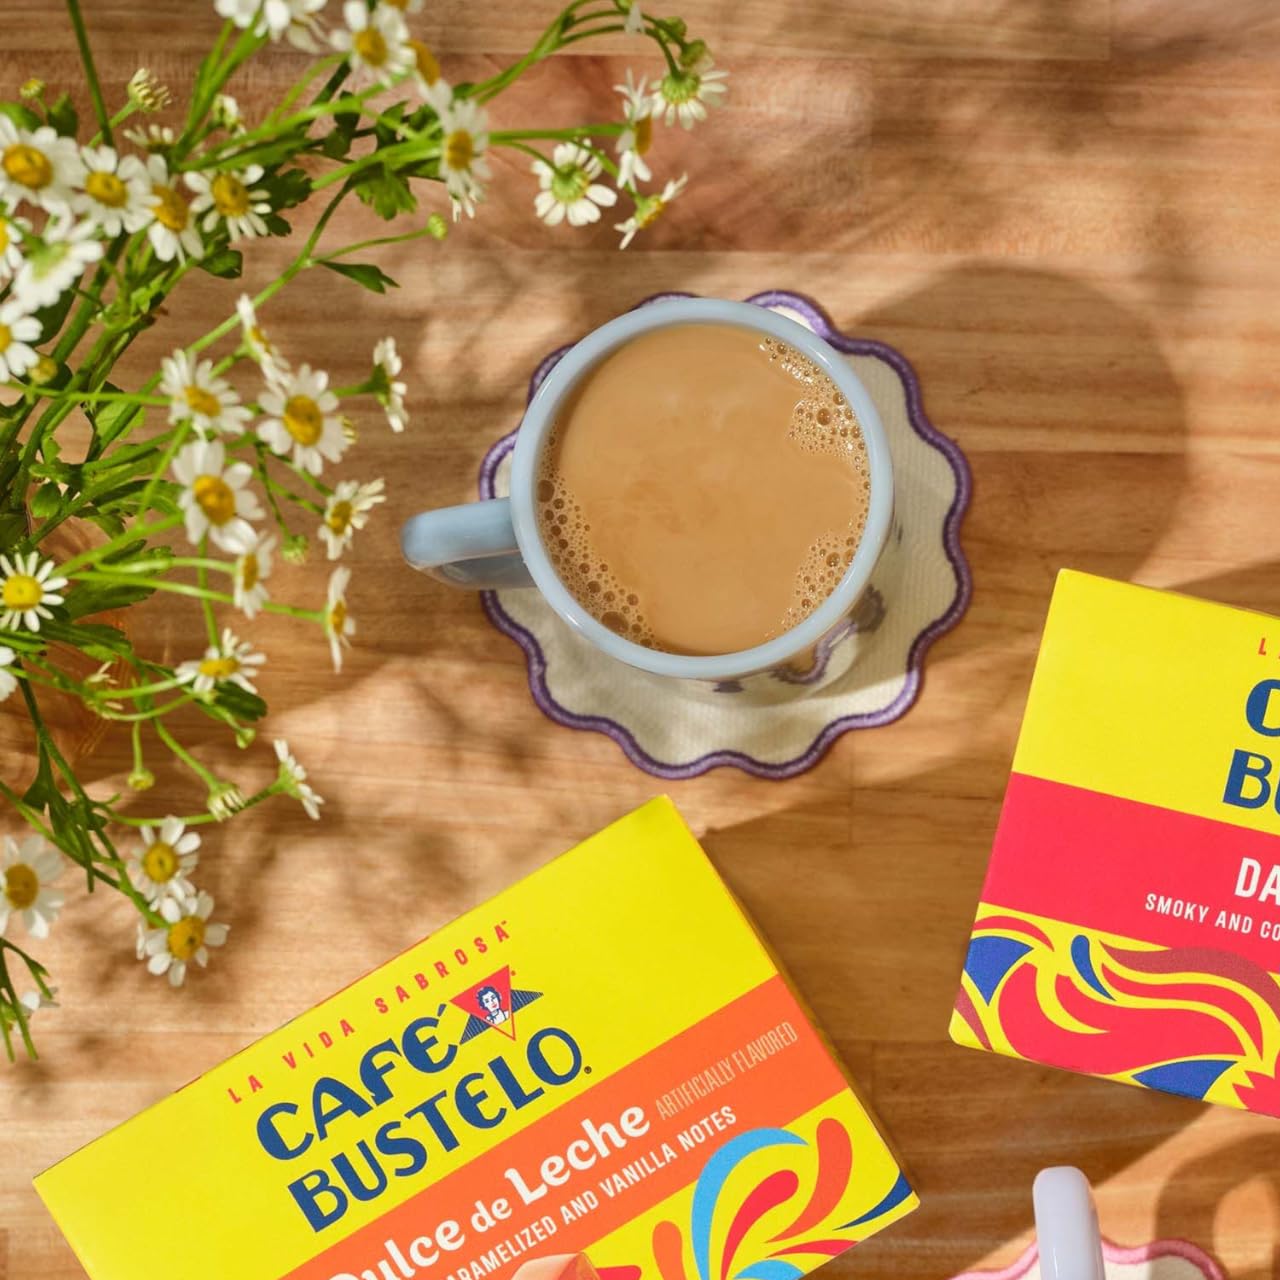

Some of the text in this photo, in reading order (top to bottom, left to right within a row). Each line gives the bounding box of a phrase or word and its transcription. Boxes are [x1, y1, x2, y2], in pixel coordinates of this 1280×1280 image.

[1146, 894, 1208, 922] SMOKY
[1216, 911, 1252, 933] AND
[227, 1074, 263, 1103] LA
[282, 1018, 353, 1069] VIDA
[656, 1022, 797, 1120] ARTIFICIALLY FLAVORED
[471, 1198, 512, 1232] de
[504, 1107, 649, 1205] Leche
[560, 1191, 598, 1224] AND
[599, 1143, 677, 1197] VANILLA
[677, 1106, 736, 1151] NOTES
